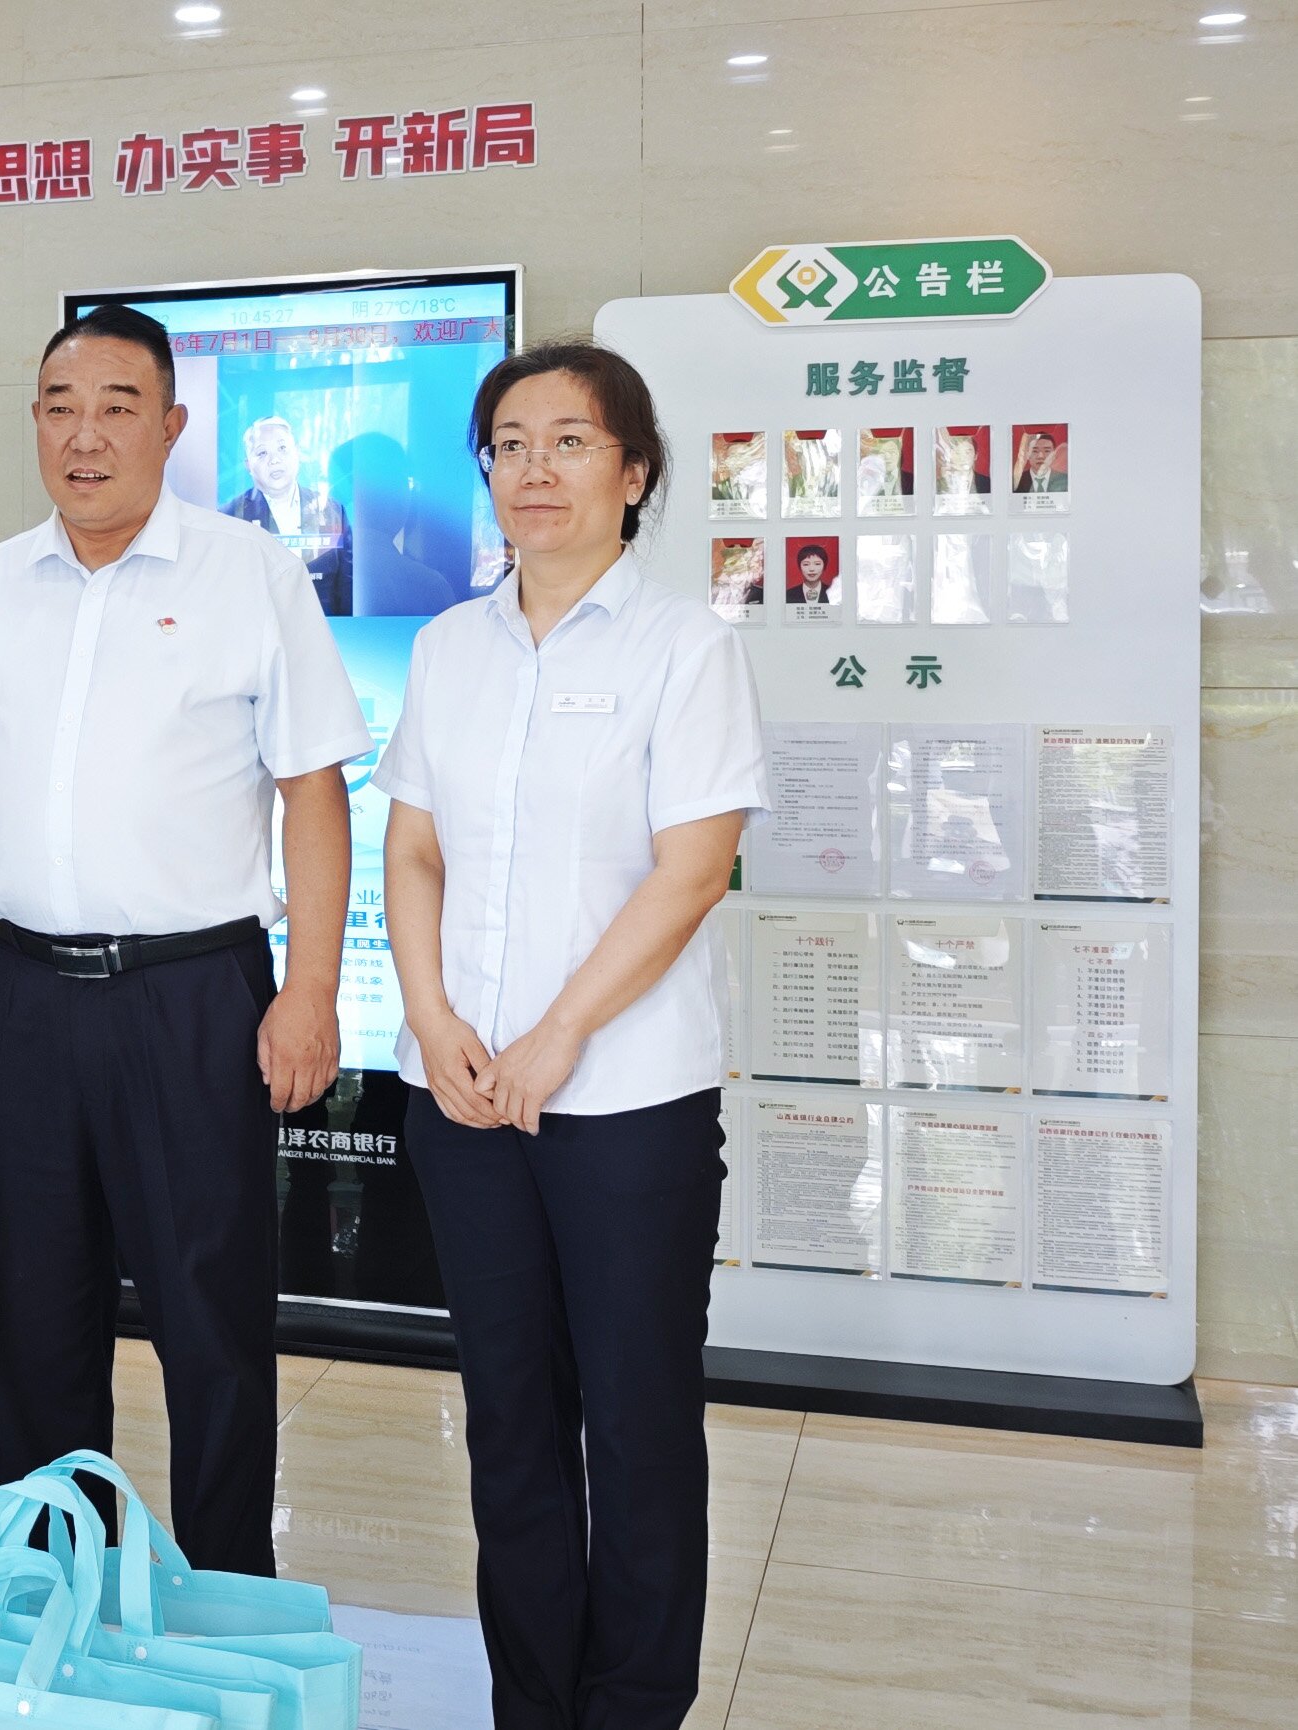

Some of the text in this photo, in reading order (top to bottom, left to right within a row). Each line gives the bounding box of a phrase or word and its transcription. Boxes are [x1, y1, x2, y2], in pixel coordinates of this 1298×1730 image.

[116, 124, 306, 193] 办实事
[335, 103, 536, 178] 开新局
[863, 260, 1004, 298] 公告栏
[232, 309, 294, 325] 10:45:27
[805, 356, 970, 397] 服务监督
[795, 936, 835, 947] 十个践行
[935, 940, 975, 950] 十个严禁
[1073, 945, 1128, 954] 七不准四公
[305, 1151, 328, 1160] RURAL
[330, 1153, 375, 1163] COMMERCIAL
[377, 1157, 397, 1165] BANK
